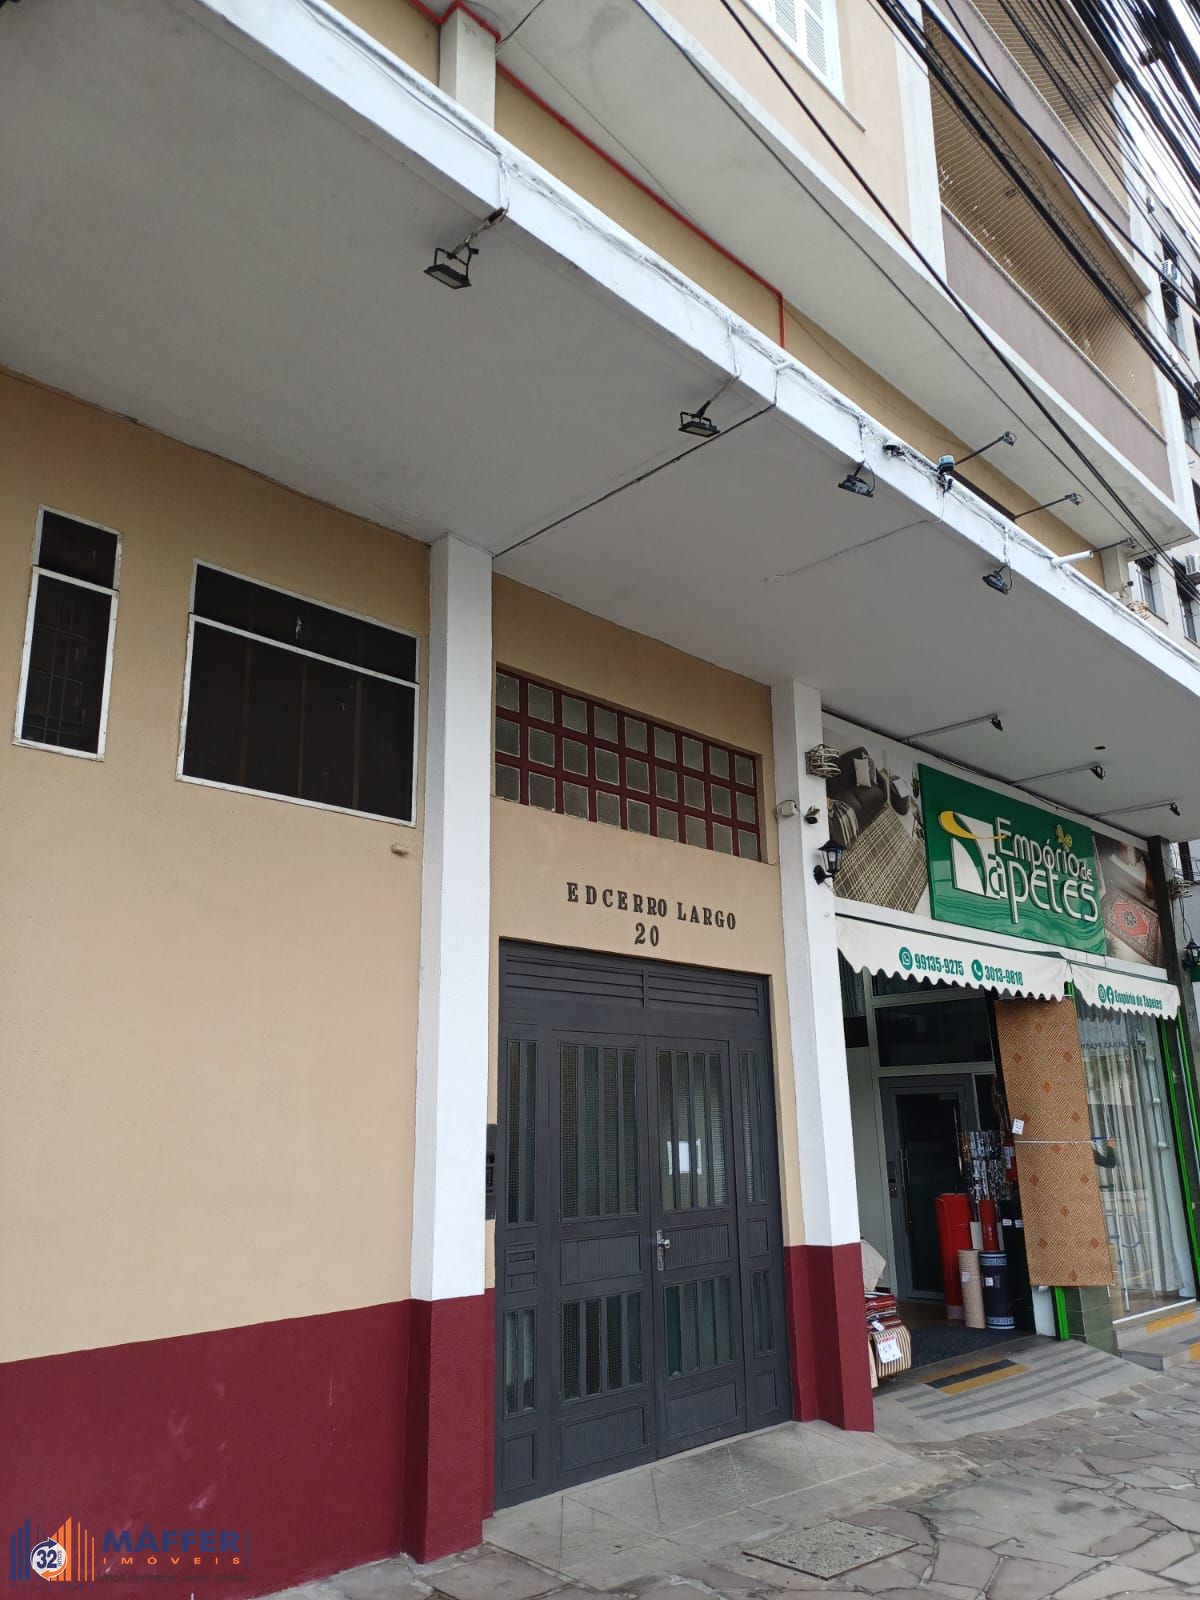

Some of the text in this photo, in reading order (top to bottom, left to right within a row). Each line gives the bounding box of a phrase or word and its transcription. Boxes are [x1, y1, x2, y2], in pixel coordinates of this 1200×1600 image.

[995, 816, 1094, 882] Empório de
[677, 902, 737, 930] LARGO
[634, 922, 660, 947] 20
[914, 953, 965, 976] 99135-9275
